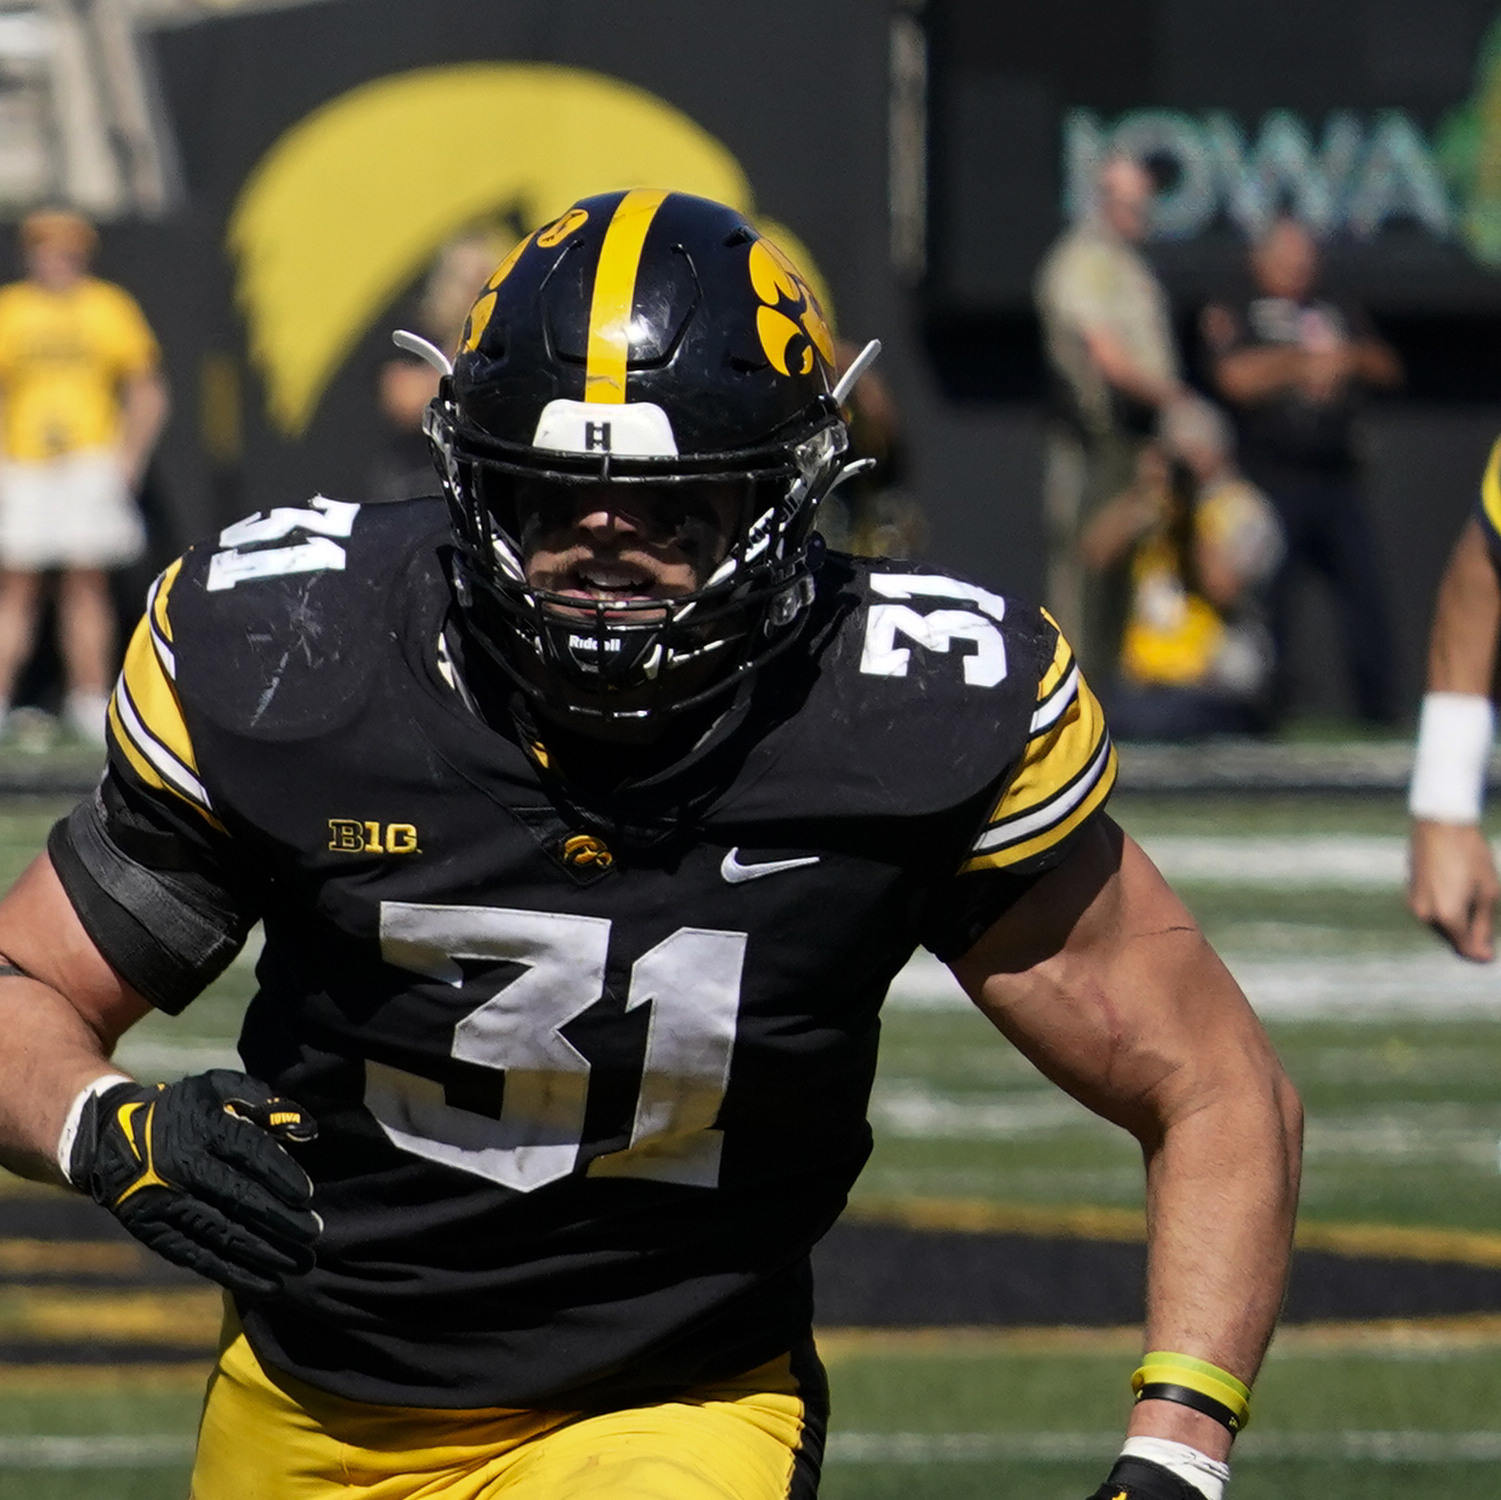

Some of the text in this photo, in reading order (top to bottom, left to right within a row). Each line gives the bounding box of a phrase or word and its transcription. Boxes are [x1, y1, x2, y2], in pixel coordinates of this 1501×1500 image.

[1061, 106, 1452, 243] IOWA
[206, 492, 362, 593] 31
[859, 572, 1008, 688] 31
[363, 900, 750, 1194] 31
[269, 1111, 302, 1127] IOWA
